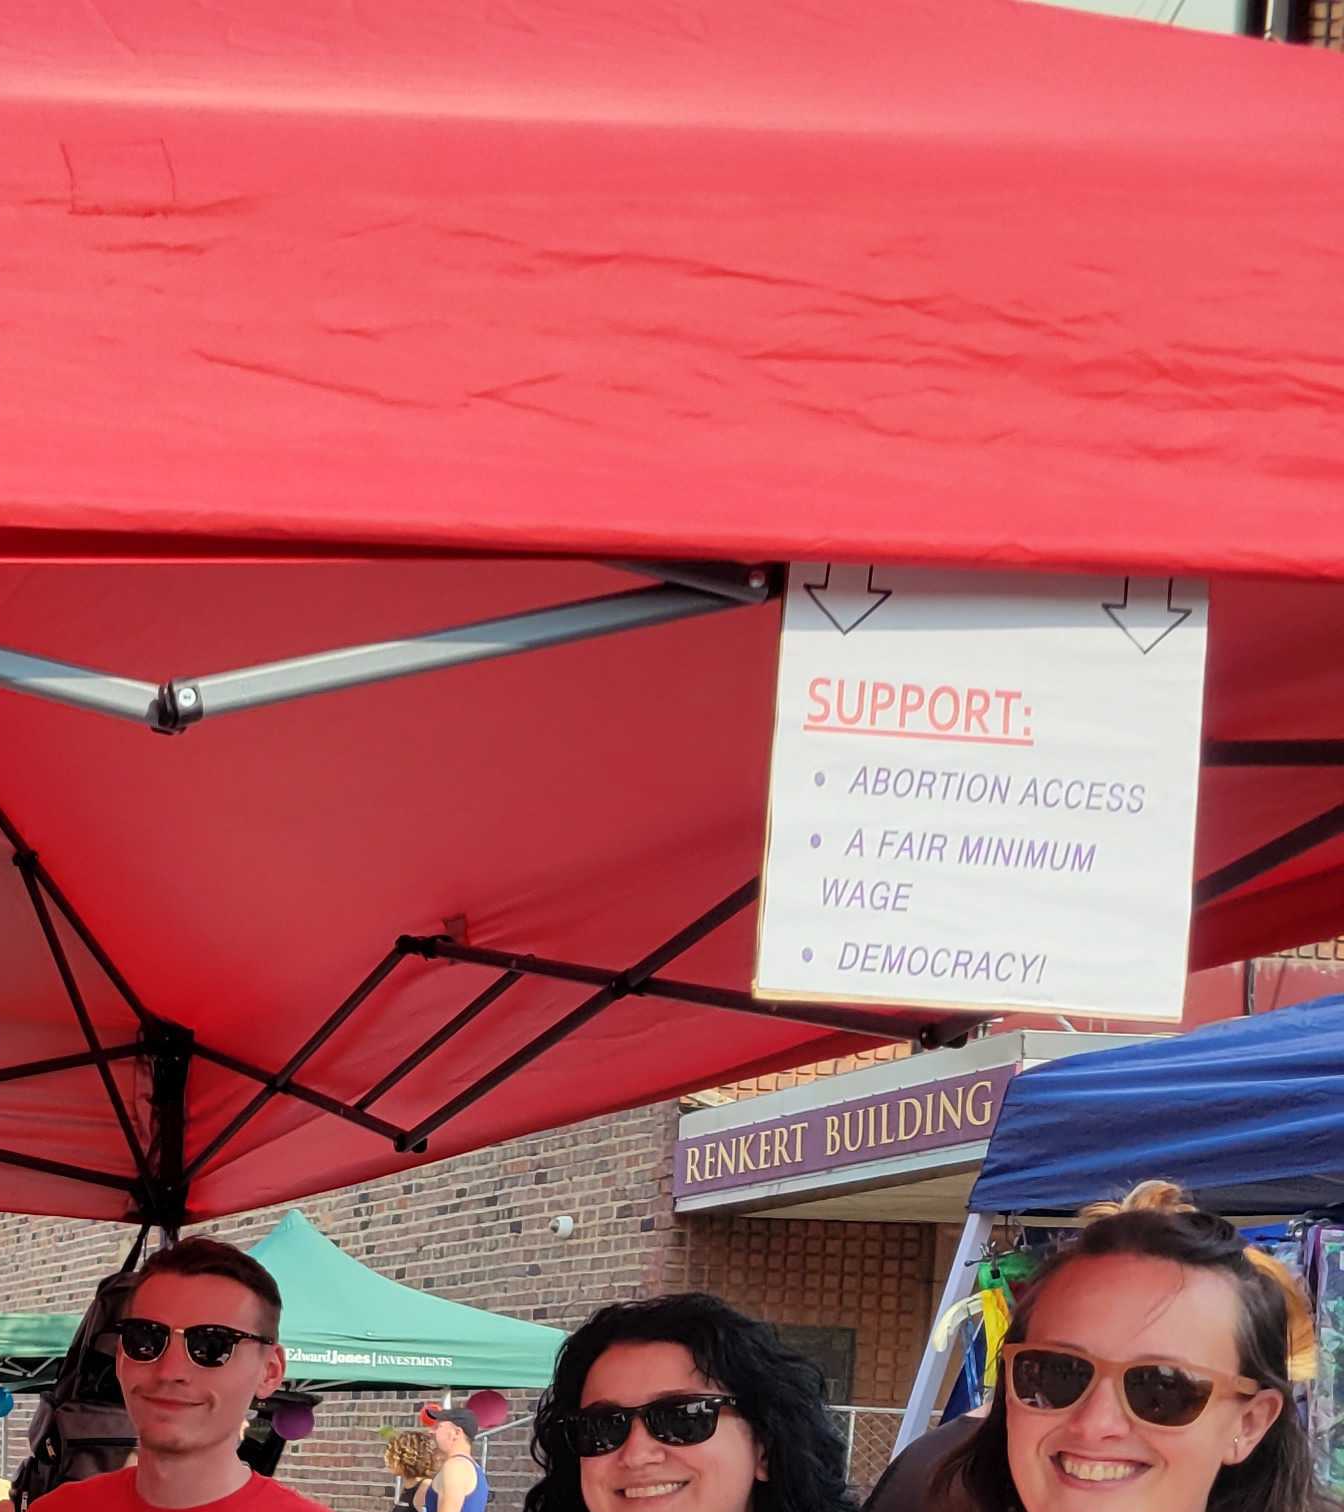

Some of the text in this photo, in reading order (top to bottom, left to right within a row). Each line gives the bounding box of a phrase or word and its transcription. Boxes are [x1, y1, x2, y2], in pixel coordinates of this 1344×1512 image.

[805, 677, 1034, 737] SUPPORT:
[848, 765, 1146, 813] ABORTION ACCESS
[844, 829, 1097, 873] A FAIR MINIMUM
[820, 877, 913, 913] WAGE
[837, 941, 1048, 985] DEMOCRACY!
[685, 1080, 994, 1184] RENKERT BUILDING
[376, 1354, 453, 1368] INVESTMENTS
